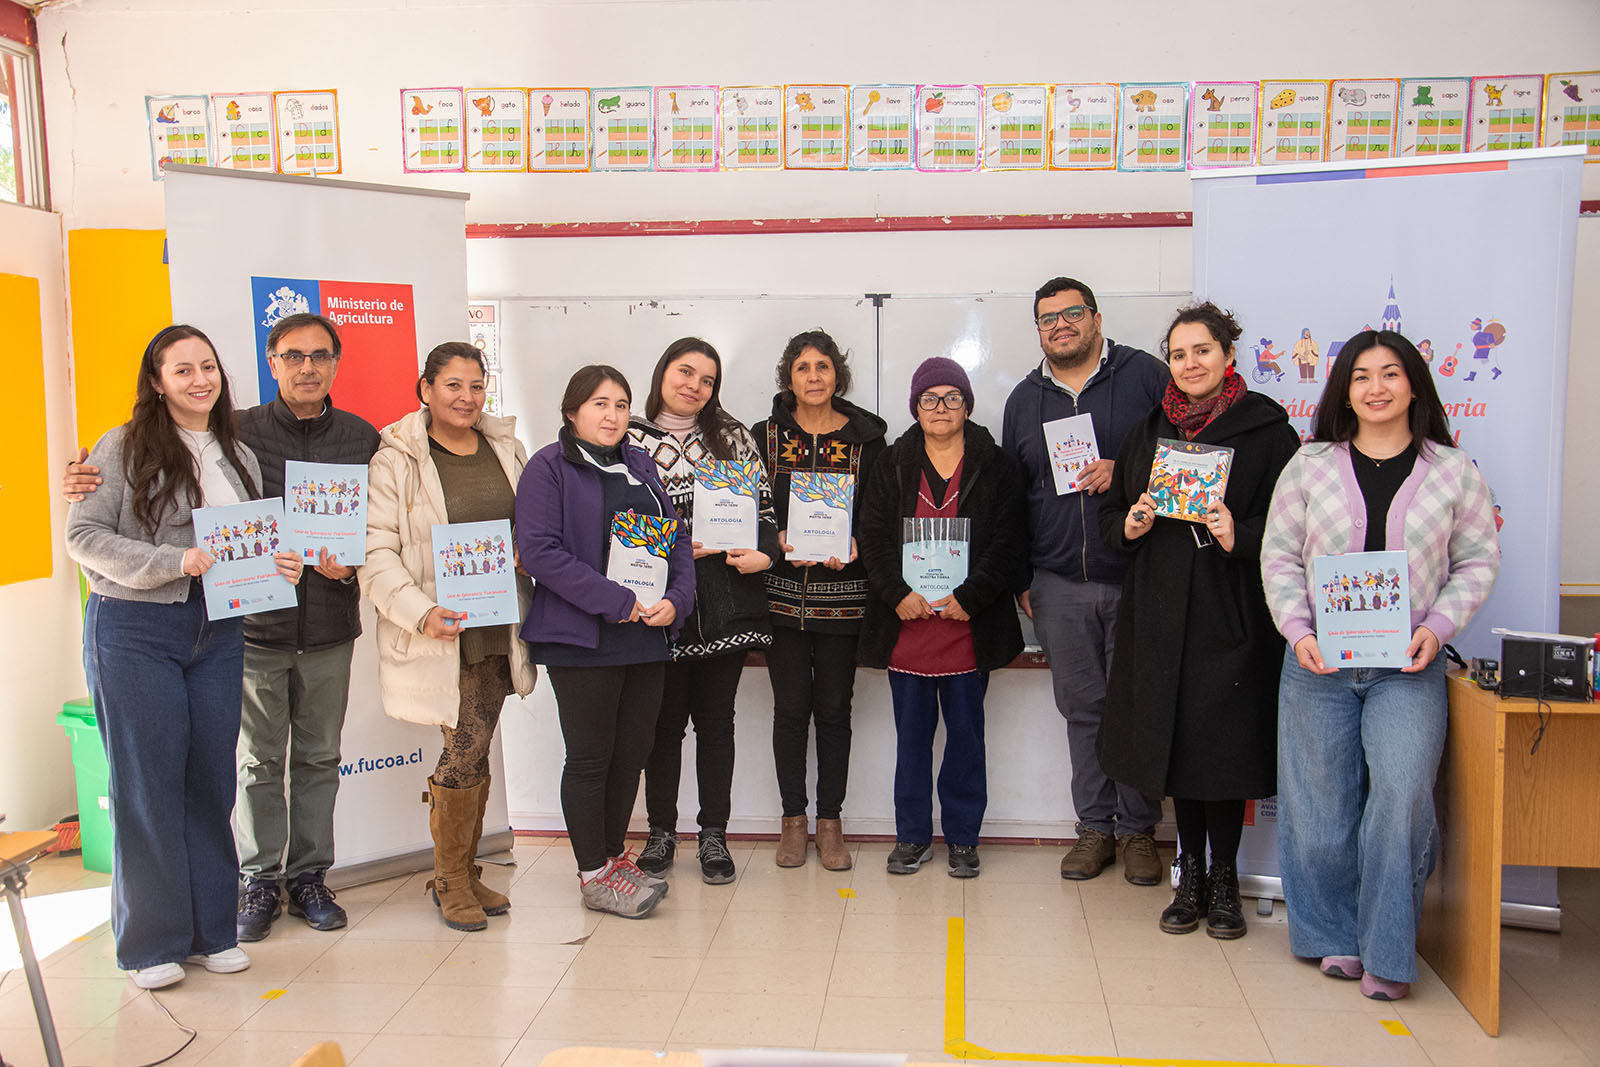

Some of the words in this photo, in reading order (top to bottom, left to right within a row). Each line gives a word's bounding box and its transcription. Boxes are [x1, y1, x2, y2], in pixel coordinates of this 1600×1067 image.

[501, 101, 516, 109] gato
[690, 99, 709, 107] jirafa
[183, 108, 200, 116] barco
[1354, 112, 1362, 126] R
[1424, 111, 1433, 126] S
[1494, 110, 1505, 124] T
[1520, 109, 1527, 124] t
[1570, 107, 1581, 122] U
[300, 123, 308, 136] D
[320, 122, 326, 136] d
[425, 120, 432, 132] F
[446, 119, 453, 132] f
[486, 120, 496, 133] G
[508, 127, 514, 141] g
[550, 120, 559, 133] H
[573, 120, 579, 133] h
[676, 118, 688, 131] J
[743, 118, 752, 131] K
[765, 118, 771, 131] k
[808, 118, 816, 131] L
[939, 118, 951, 130] M
[1006, 117, 1015, 131] N
[1029, 123, 1035, 131] n
[1144, 116, 1153, 131] O
[1215, 114, 1223, 128] P
[1237, 122, 1244, 136] p
[1283, 114, 1293, 128] Q
[1306, 122, 1313, 136] q
[172, 127, 179, 141] B
[193, 128, 200, 140] b
[235, 124, 245, 138] C
[328, 296, 387, 311] Ministerio
[390, 299, 404, 311] de
[328, 311, 393, 326] Agricultura
